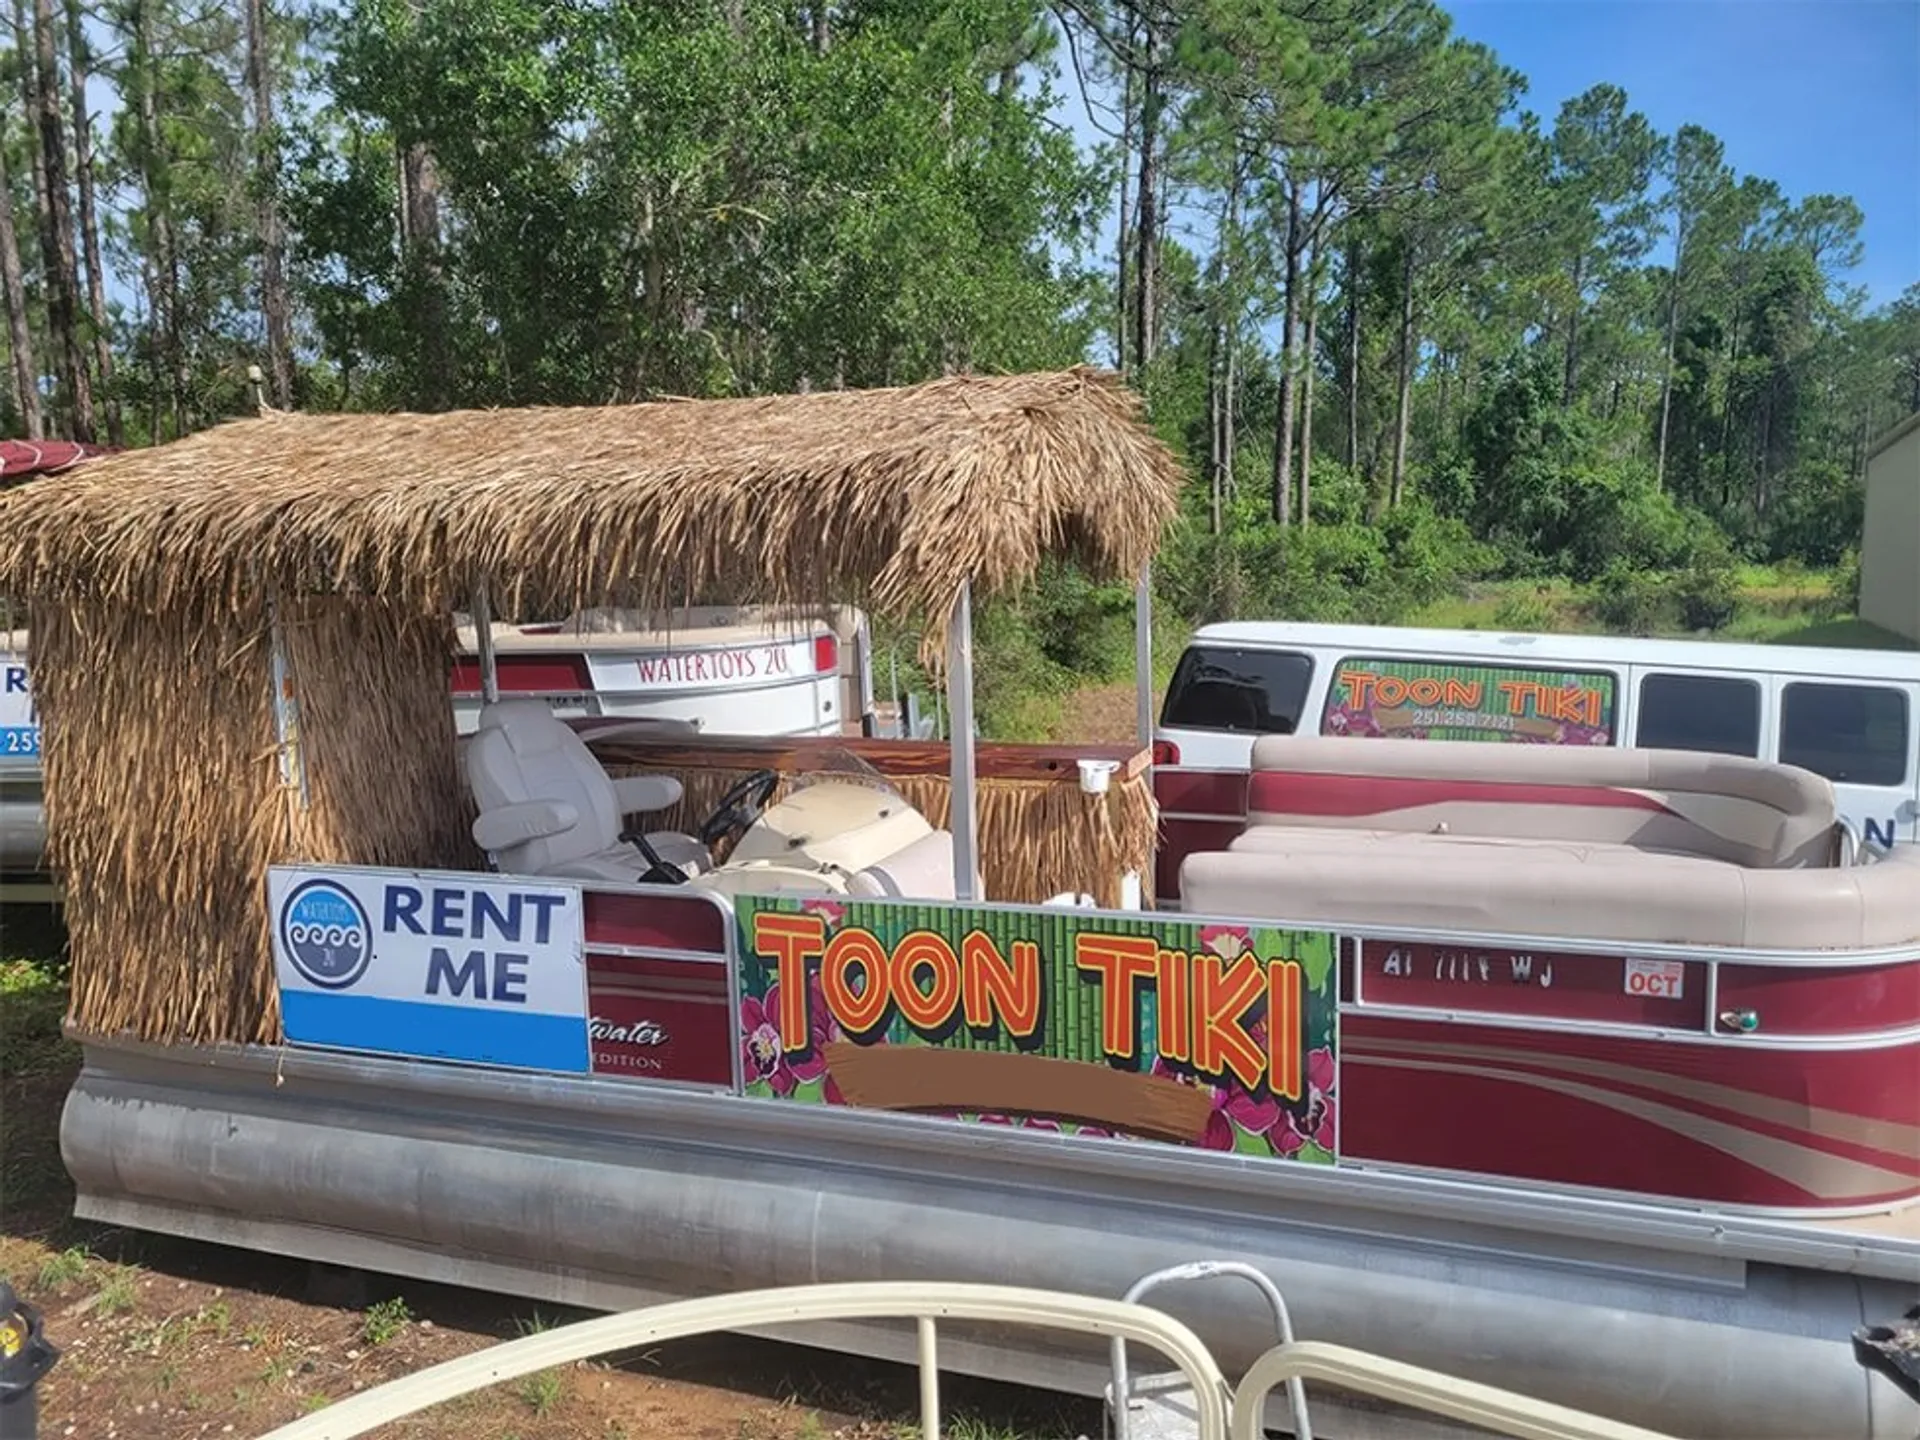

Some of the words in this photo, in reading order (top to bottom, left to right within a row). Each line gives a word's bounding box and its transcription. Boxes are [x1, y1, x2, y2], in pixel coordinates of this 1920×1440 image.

[636, 651, 756, 684] WATERTOYS
[1340, 671, 1482, 711] TOON
[1499, 681, 1601, 727] TIKI
[383, 884, 566, 945] RENT
[425, 947, 528, 1004] ME
[1630, 972, 1678, 996] OCT
[754, 911, 1041, 1053] TOON
[1075, 932, 1303, 1101] TIKI
